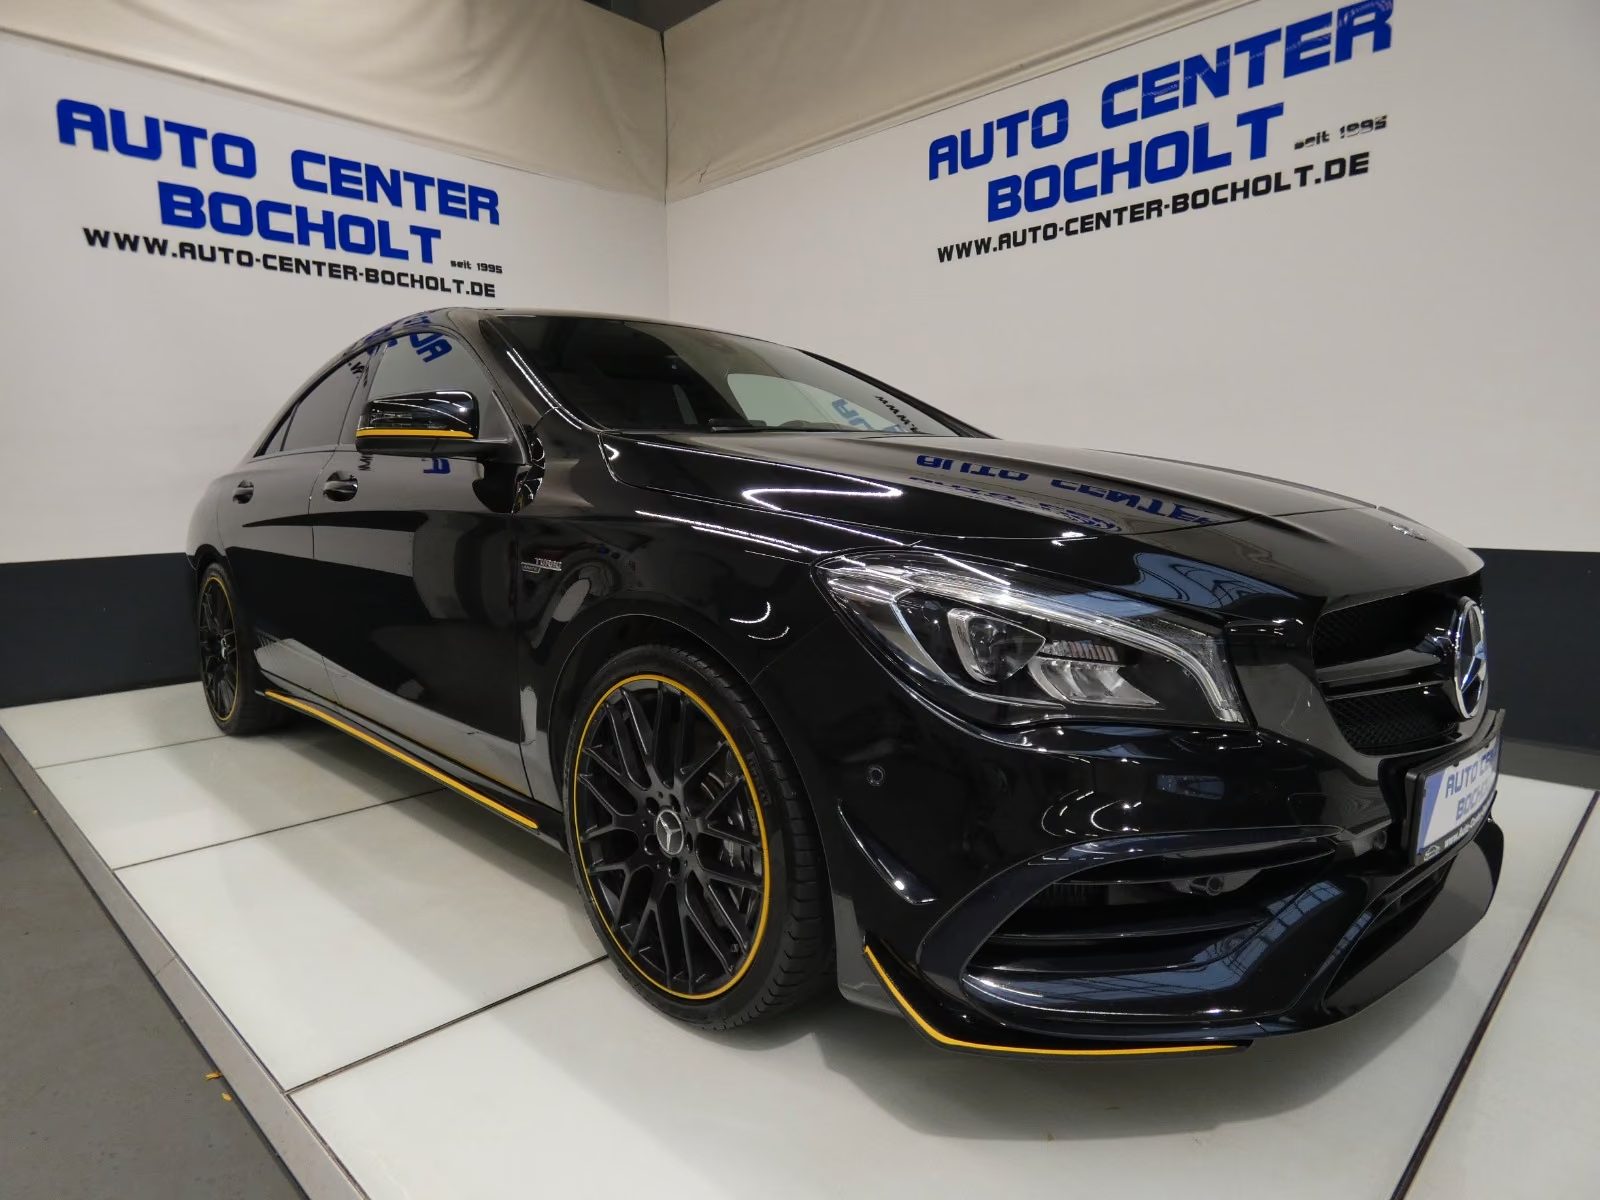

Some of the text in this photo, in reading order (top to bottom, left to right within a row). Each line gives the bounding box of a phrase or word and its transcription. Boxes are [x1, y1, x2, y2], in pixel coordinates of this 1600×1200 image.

[929, 0, 1394, 180] AUTO CENTER
[56, 98, 500, 225] AUTO CENTER
[988, 102, 1285, 222] BOCHOLT
[158, 181, 503, 274] BOCHOLT seit 1995
